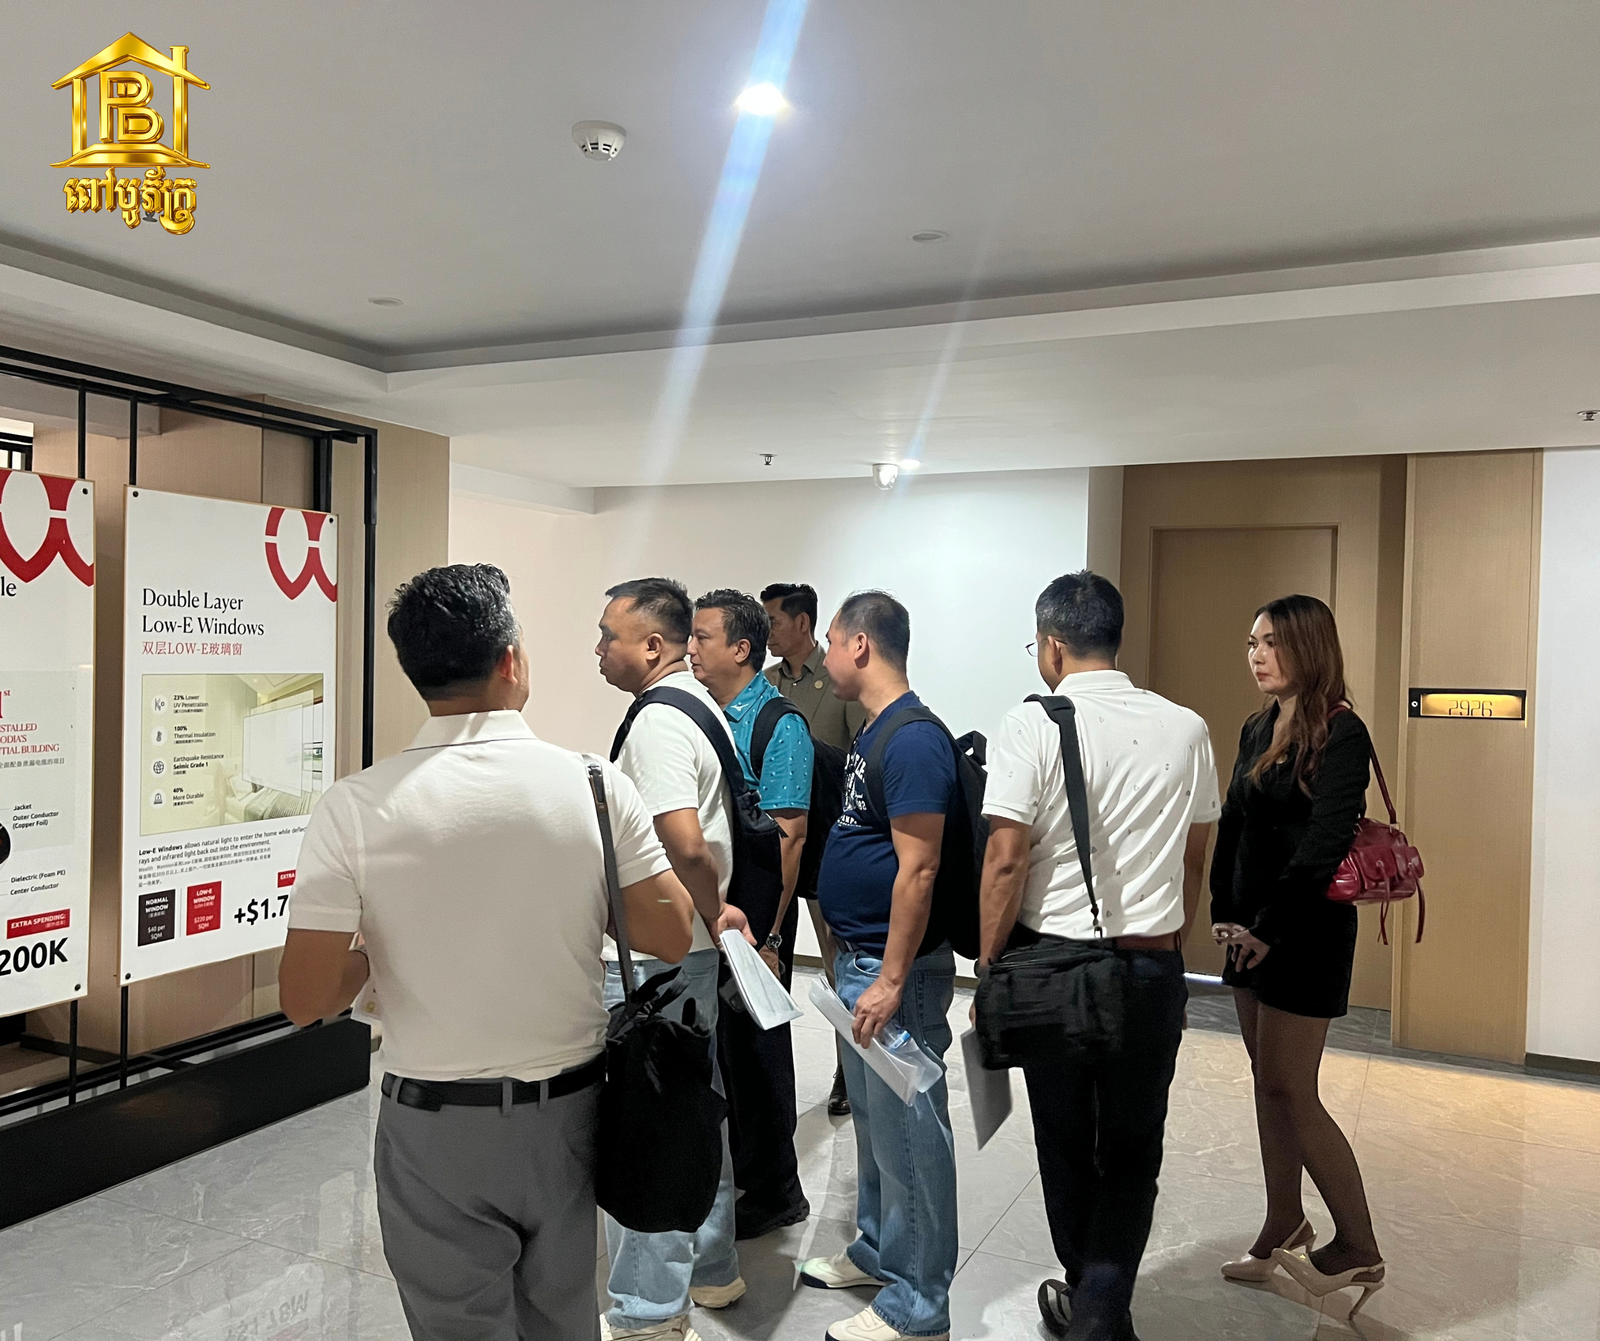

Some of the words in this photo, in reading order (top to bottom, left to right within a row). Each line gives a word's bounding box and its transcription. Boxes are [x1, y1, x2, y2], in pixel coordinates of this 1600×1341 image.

[0, 576, 17, 597] le
[143, 588, 200, 608] Double
[203, 592, 244, 613] Layer
[143, 615, 194, 634] Low-E
[197, 617, 265, 636] Windows
[142, 641, 243, 656] 双层LOW-E玻璃窗
[21, 743, 60, 754] BUILDING
[30, 811, 59, 819] Conductor
[12, 821, 35, 830] (Copper
[138, 848, 156, 856] Low-E
[158, 845, 183, 853] Windows
[201, 838, 220, 846] natural
[162, 852, 184, 860] infrared
[184, 850, 196, 858] light
[239, 839, 271, 849] environment.
[10, 874, 38, 883] Dielectric
[38, 872, 55, 880] (Foam
[280, 872, 295, 880] EXTRA
[10, 887, 30, 895] Center
[30, 883, 59, 892] Conductor
[196, 888, 213, 896] LOW-E
[145, 896, 169, 906] NORMAL
[193, 895, 216, 904] WINDOW
[145, 903, 169, 913] WINDOW
[234, 894, 289, 926] +$1.7
[11, 920, 33, 929] EXTRA
[33, 913, 66, 924] SPENDING:
[197, 922, 210, 930] SQM
[150, 932, 163, 940] SQM
